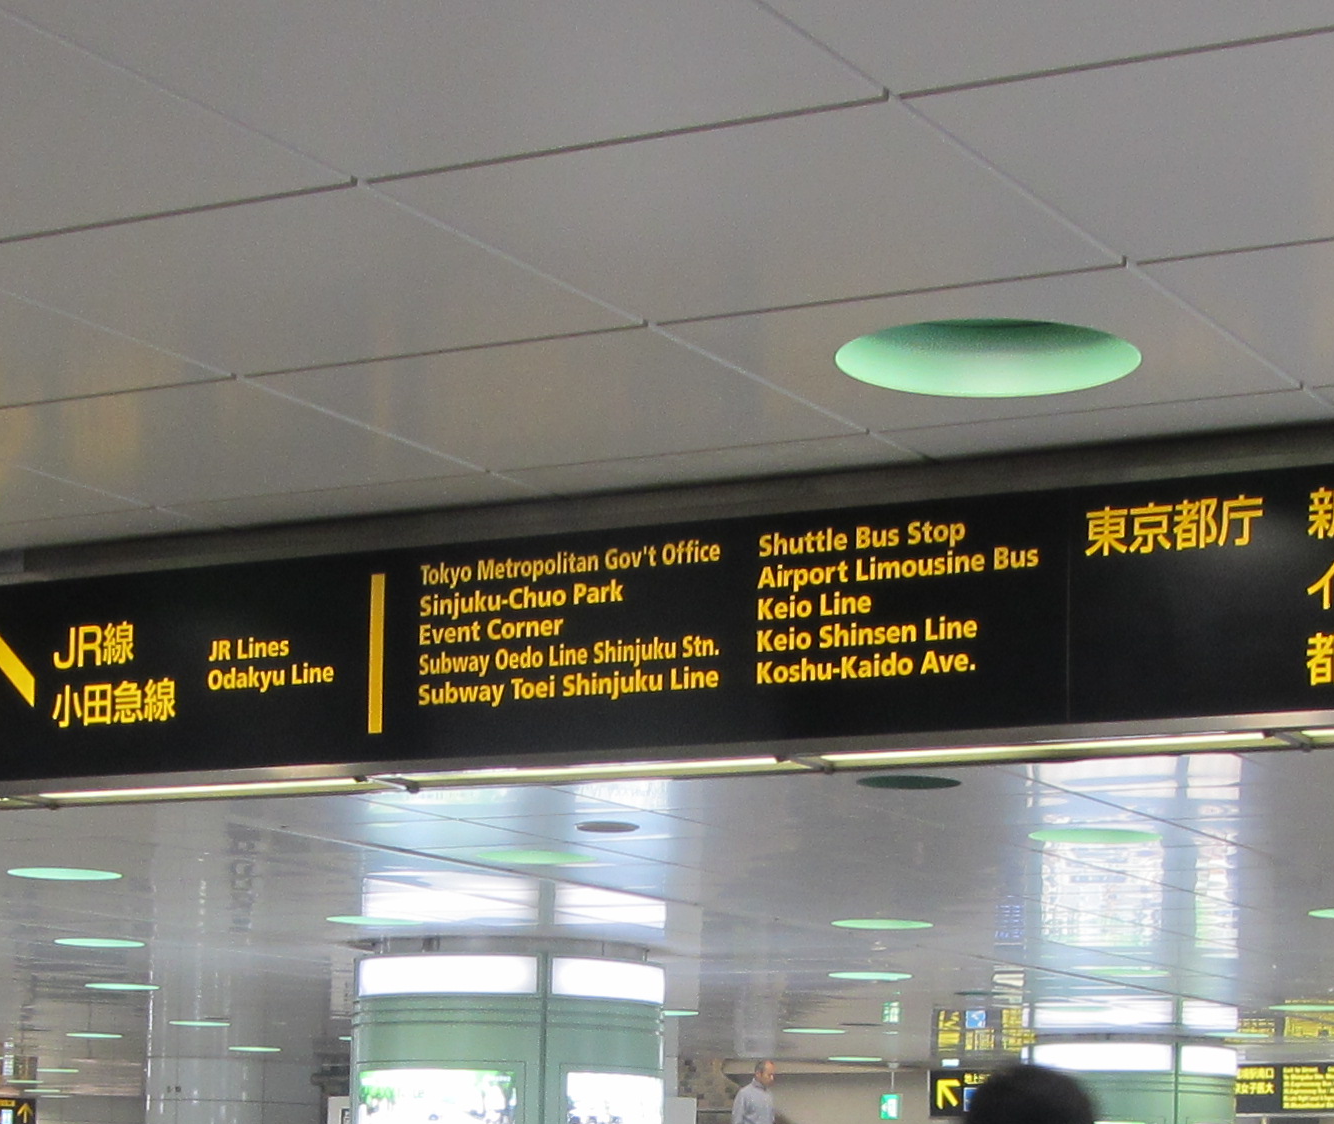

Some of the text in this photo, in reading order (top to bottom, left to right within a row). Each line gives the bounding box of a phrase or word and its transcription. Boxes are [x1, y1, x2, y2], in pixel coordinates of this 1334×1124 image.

[759, 521, 966, 557] Shuttle Bus Stop
[1085, 495, 1263, 556] 東京都庁
[423, 540, 721, 585] Tokyo Metropolitan Gov't Office
[758, 547, 1039, 589] Airport Limousine Bus
[421, 579, 623, 617] Sinjuku-Chuo Park
[757, 591, 872, 620] Keio Line
[53, 621, 134, 670] JR線
[208, 638, 290, 661] JR Lines
[419, 618, 564, 645] Event Corner
[757, 617, 978, 652] Keio Shinsen Line
[419, 635, 719, 675] Subway Oedo Line Shinjuku Stn.
[756, 650, 976, 684] Koshu-Kaido Ave.
[207, 663, 334, 690] Odakyu Line
[419, 667, 719, 705] Subway Toei Shinjuku Line
[52, 677, 176, 728] 小田急線
